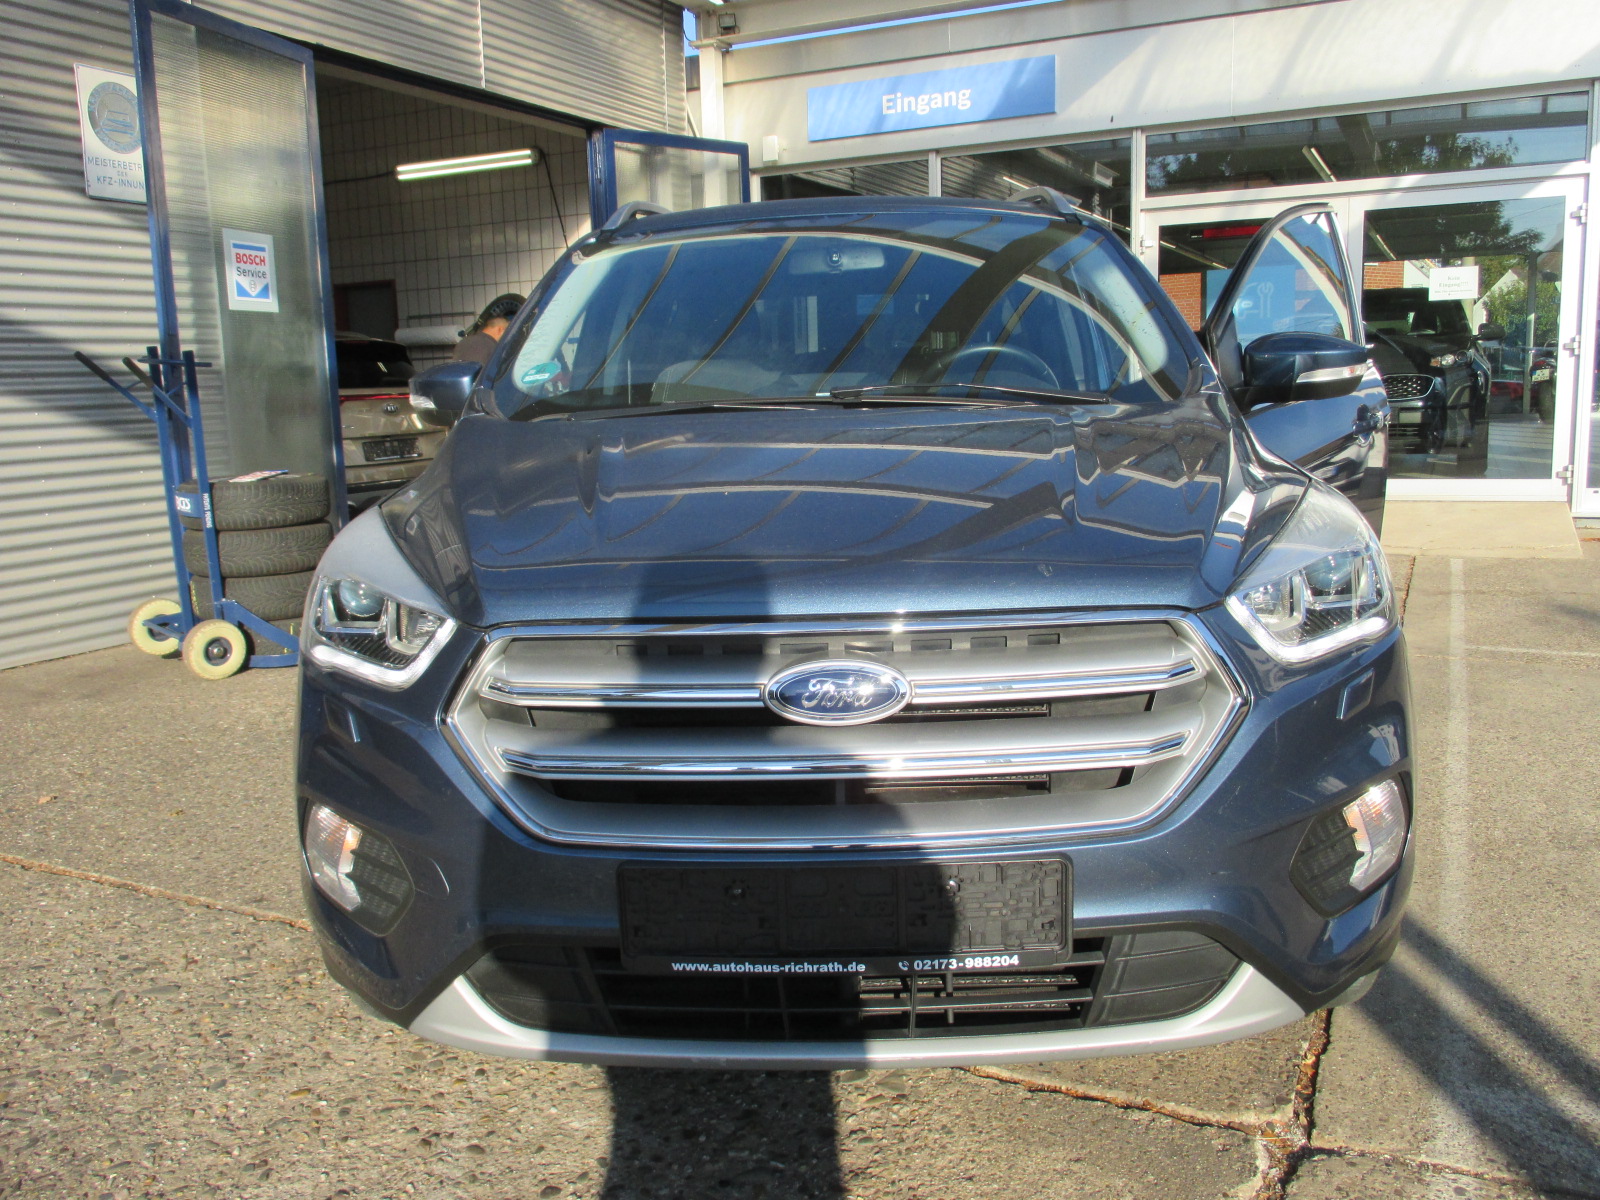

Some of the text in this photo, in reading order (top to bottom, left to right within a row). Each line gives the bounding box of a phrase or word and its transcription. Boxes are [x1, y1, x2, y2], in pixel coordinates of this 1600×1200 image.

[882, 88, 972, 115] Eingang
[235, 252, 267, 267] BOSCH
[236, 266, 268, 279] Service
[801, 677, 873, 709] Ford
[671, 954, 1020, 973] www.autohaus-richrath.de 02173-988204
